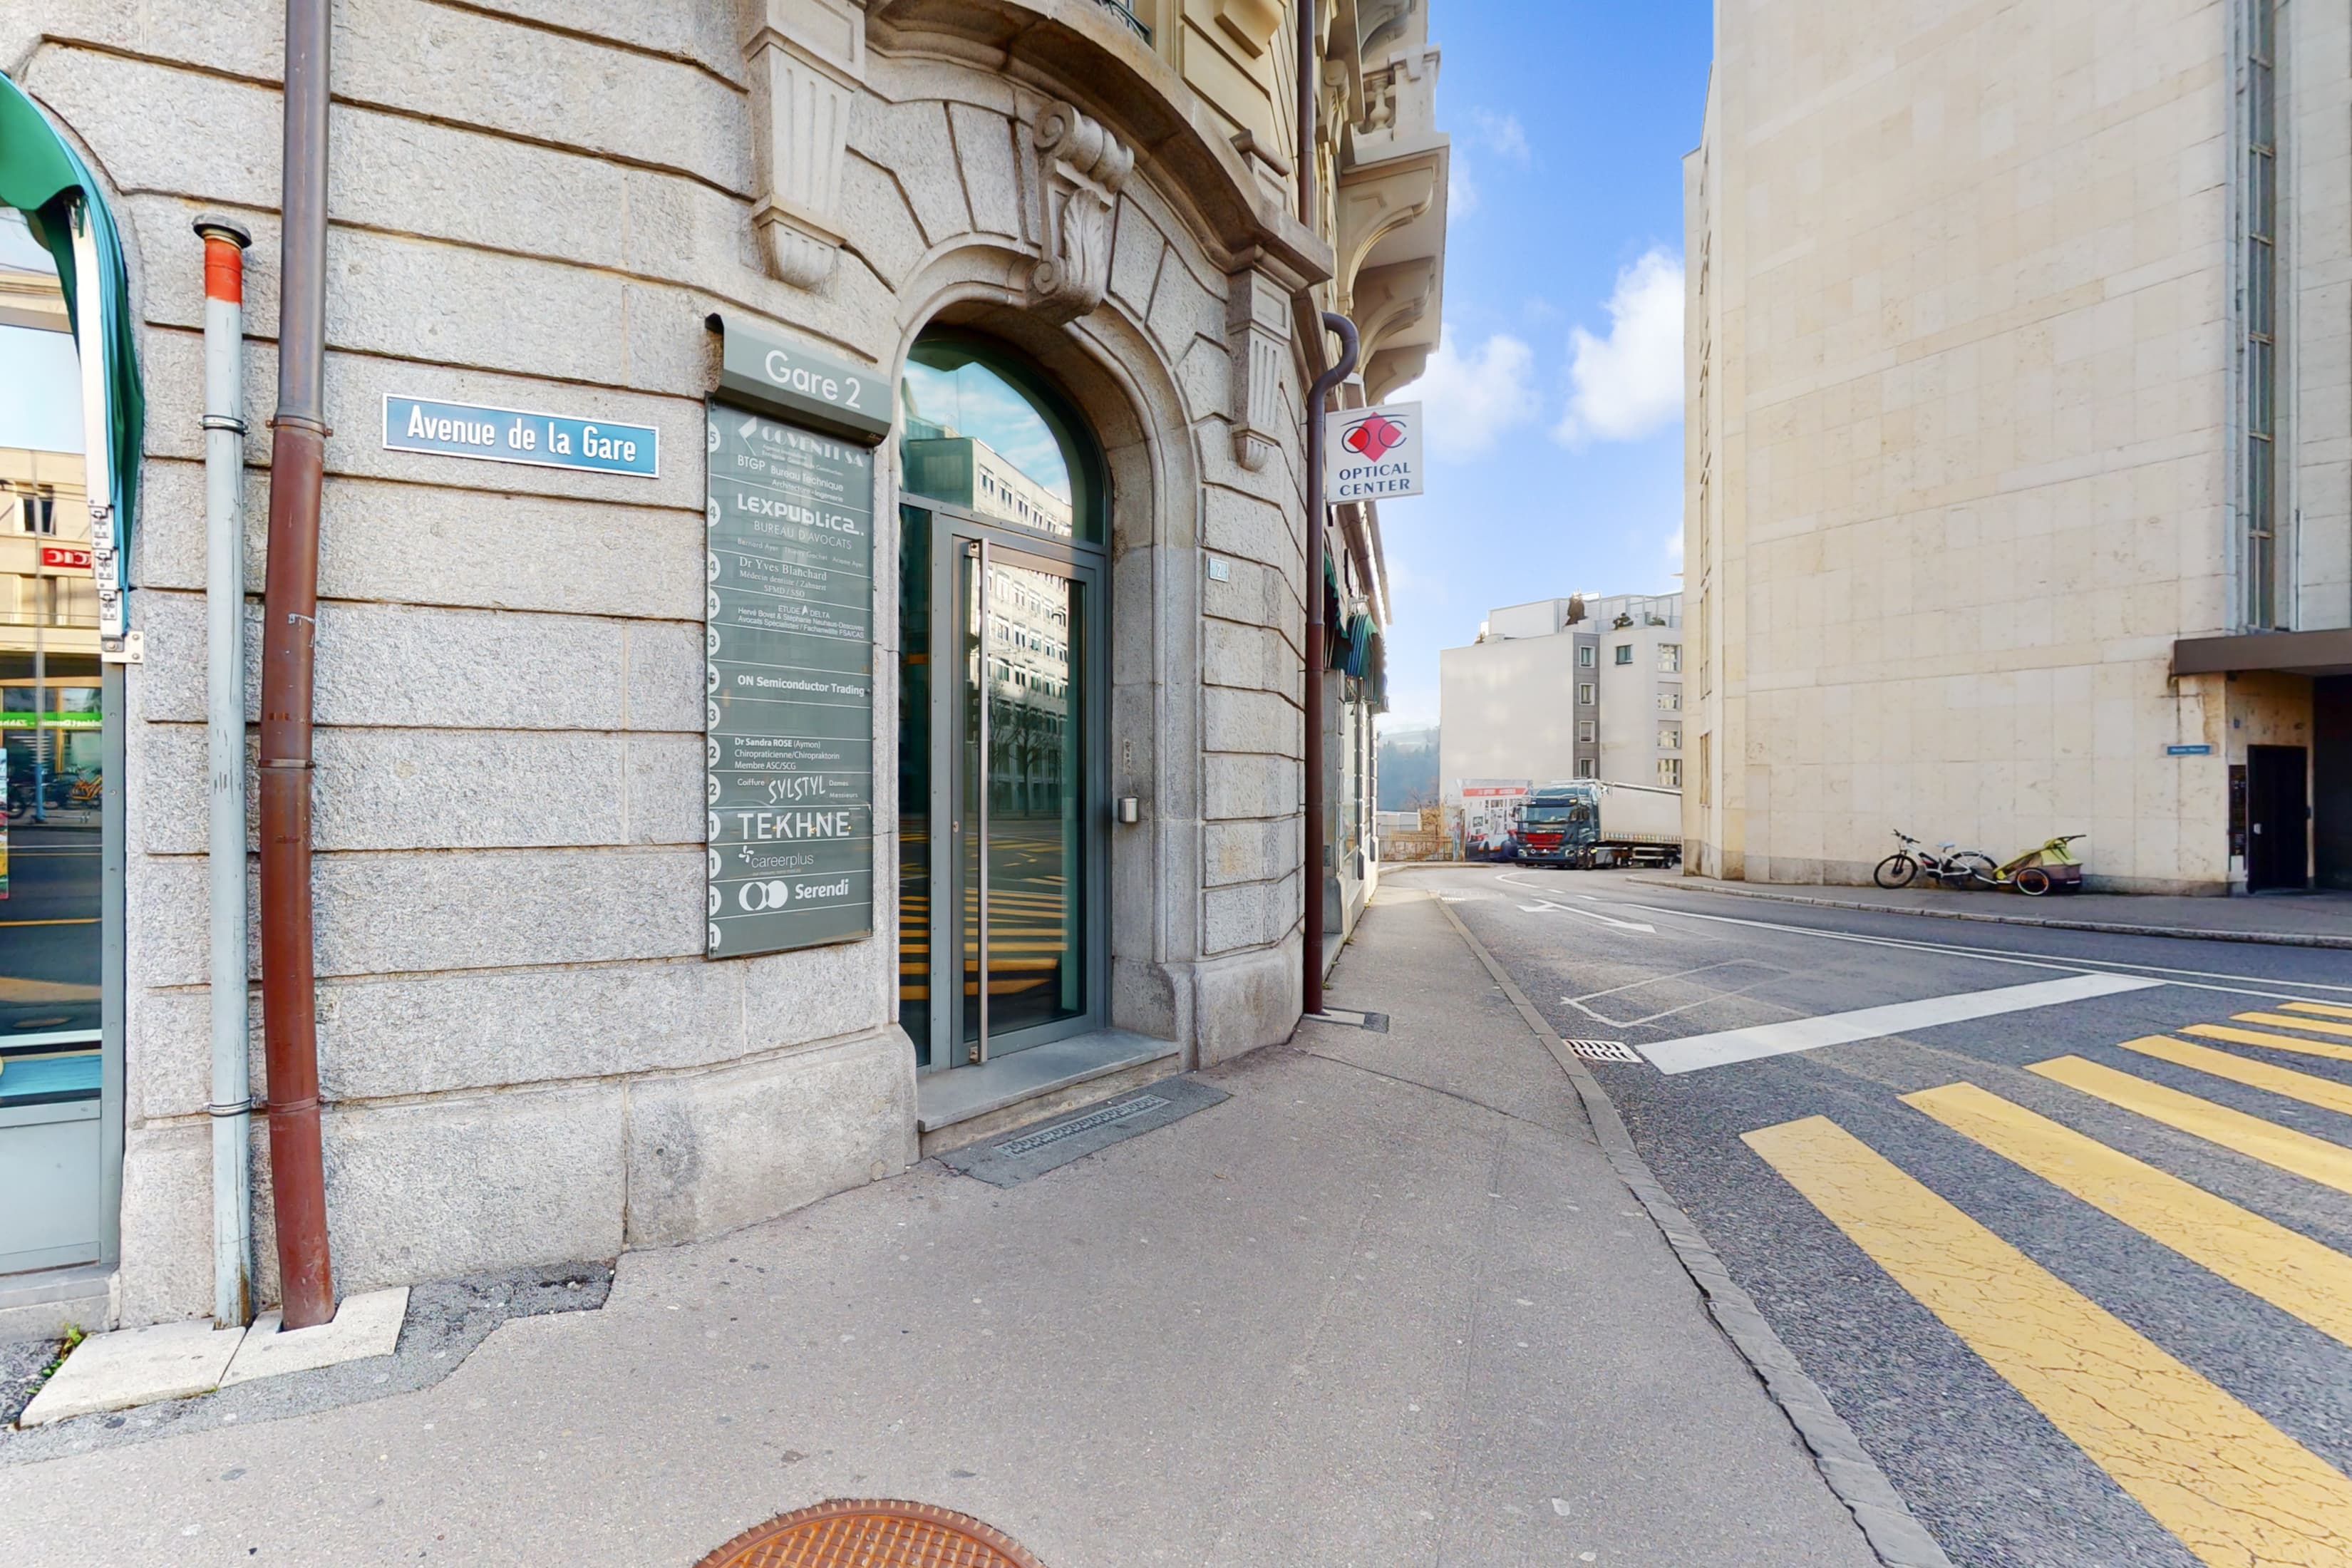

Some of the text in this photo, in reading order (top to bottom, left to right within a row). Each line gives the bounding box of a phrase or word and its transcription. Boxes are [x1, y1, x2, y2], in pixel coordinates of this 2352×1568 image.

[765, 349, 861, 408] Gare 2
[407, 404, 636, 462] Avenue de la Gare
[709, 431, 716, 443] 5
[738, 455, 765, 471] BTGP
[1339, 462, 1411, 480] OPTICAL
[770, 465, 843, 492] Bureau Technique
[1339, 478, 1410, 496] CENTER
[753, 520, 794, 538] BUREAU
[739, 556, 827, 581] Dr Yves Blanchard
[778, 605, 830, 619] ETUDE DELTA
[709, 635, 716, 647] 3
[738, 675, 865, 697] ON Semiconductor Trading
[709, 708, 716, 721] 3
[735, 737, 820, 749] Dr Sandra ROSE (Aymon)
[709, 746, 716, 759] 2
[735, 760, 796, 770] Membre ASC/SCG
[709, 783, 716, 795] 2
[768, 775, 826, 804] SYLSTYL
[737, 811, 850, 840] TEKHNE
[751, 852, 815, 868] careerplus
[795, 879, 850, 899] Serendi
